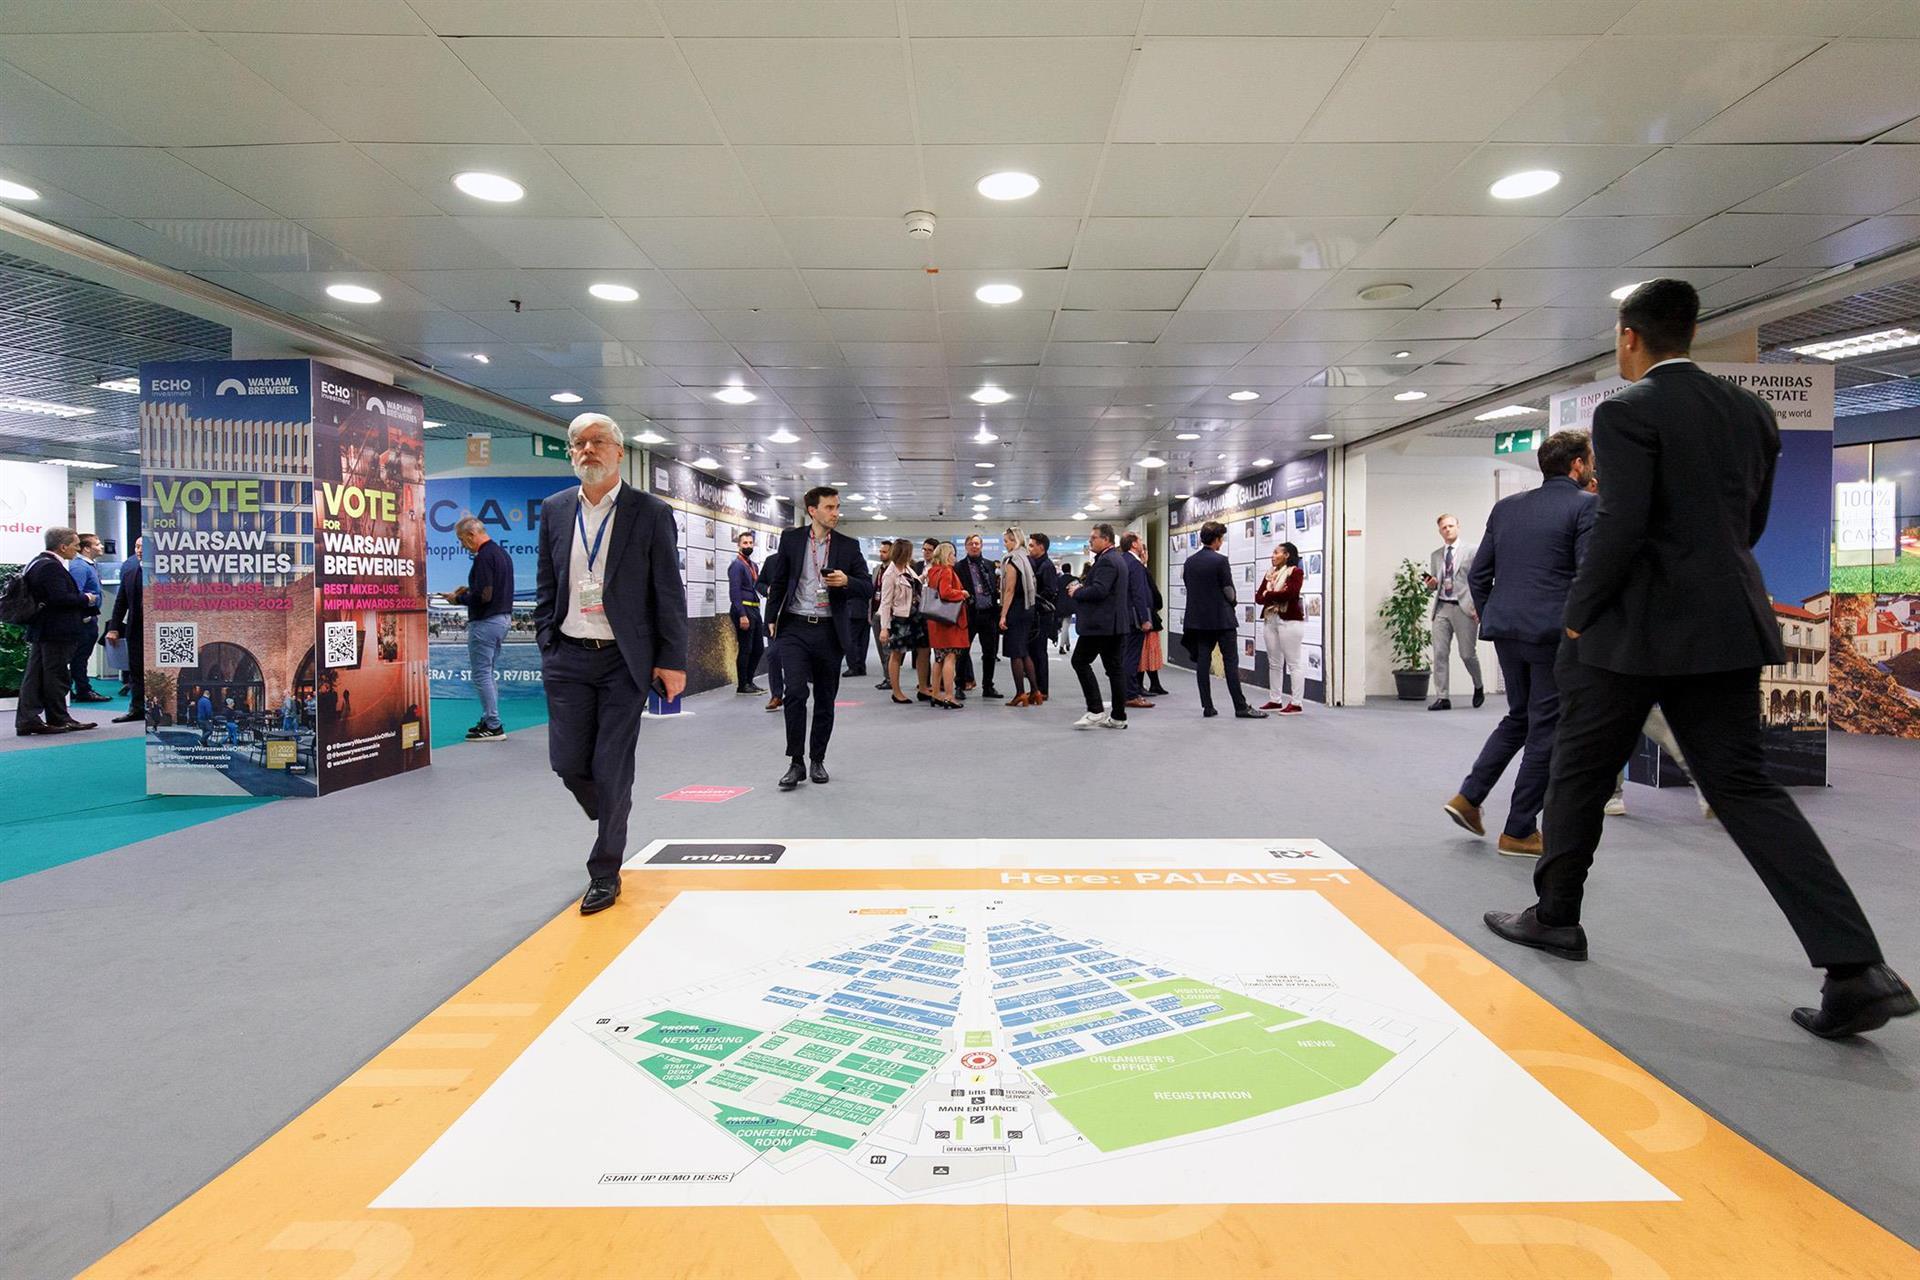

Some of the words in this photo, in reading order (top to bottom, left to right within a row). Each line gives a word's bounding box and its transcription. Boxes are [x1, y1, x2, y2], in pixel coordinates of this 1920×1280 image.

[152, 380, 191, 390] ECHO
[248, 377, 292, 386] WARSAW
[1752, 376, 1813, 387] PARIBAS
[248, 386, 299, 395] BREWERIES
[321, 381, 350, 398] ECHO
[1757, 390, 1808, 401] ESTATE
[1788, 409, 1812, 418] world
[1239, 478, 1273, 504] GALLERY
[153, 480, 259, 513] VOTE
[322, 482, 396, 522] VOTE
[0, 523, 42, 533] ndler
[154, 519, 176, 528] FOR
[323, 520, 341, 530] FOR
[153, 531, 266, 550] WARSAW
[323, 532, 400, 555] WARSAW
[155, 554, 291, 573] BREWERIES
[324, 555, 415, 576] BREWERIES
[154, 583, 187, 594] BEST
[190, 583, 263, 594] MIXED-USE
[324, 584, 348, 594] BEST
[350, 584, 399, 595] MIXED-USE
[196, 599, 255, 609] AWARDS
[258, 599, 292, 609] 2022
[324, 599, 353, 610] MIPIM
[357, 599, 395, 609] AWARDS
[396, 599, 416, 608] 2022
[503, 670, 542, 680] R7/B12
[1000, 871, 1121, 884] Here:
[1135, 872, 1297, 885] PALAIS
[660, 1036, 743, 1044] NETWORKING
[1297, 1040, 1336, 1048] NEWS
[1089, 1056, 1176, 1064] ORGANISER'S
[1112, 1063, 1157, 1071] OFFICE
[1153, 1091, 1252, 1100] REGISTRATION
[736, 1128, 818, 1137] CONFERENCE
[754, 1138, 793, 1147] ROOM
[603, 1174, 638, 1182] START
